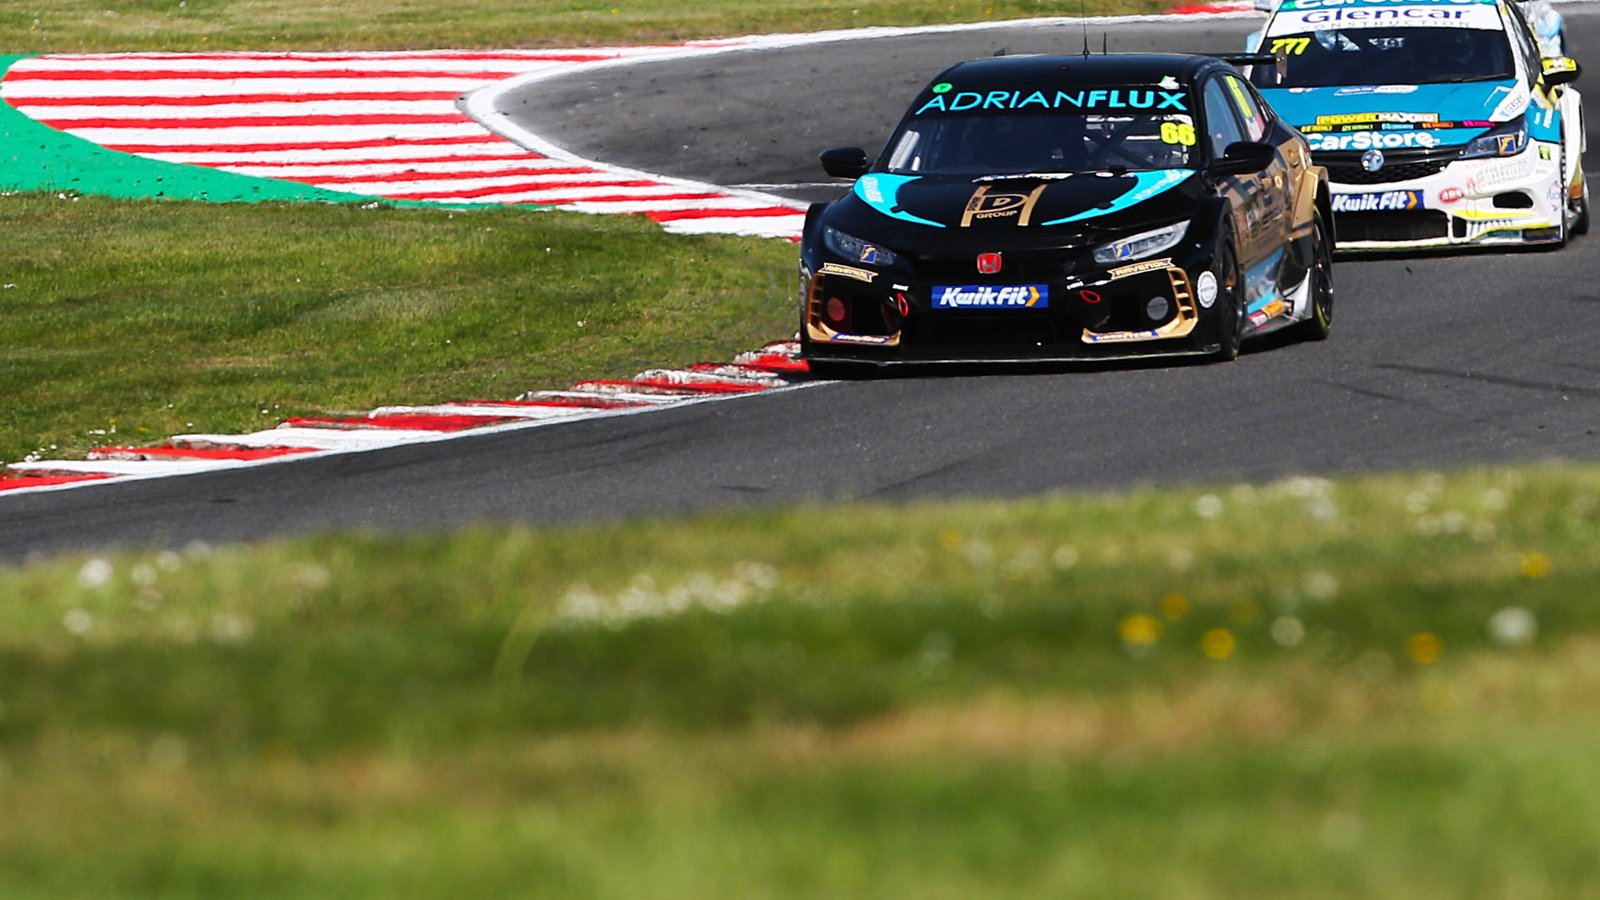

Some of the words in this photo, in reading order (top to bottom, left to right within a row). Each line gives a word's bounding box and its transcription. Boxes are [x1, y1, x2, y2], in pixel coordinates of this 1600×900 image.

[1301, 8, 1471, 23] Glencar
[1300, 20, 1470, 31] CONSTRUCTION
[1270, 37, 1311, 56] 777
[1160, 122, 1196, 146] 66
[1306, 131, 1434, 151] CarStore
[976, 210, 1018, 219] GROUP
[1114, 260, 1169, 276] RAVENOL
